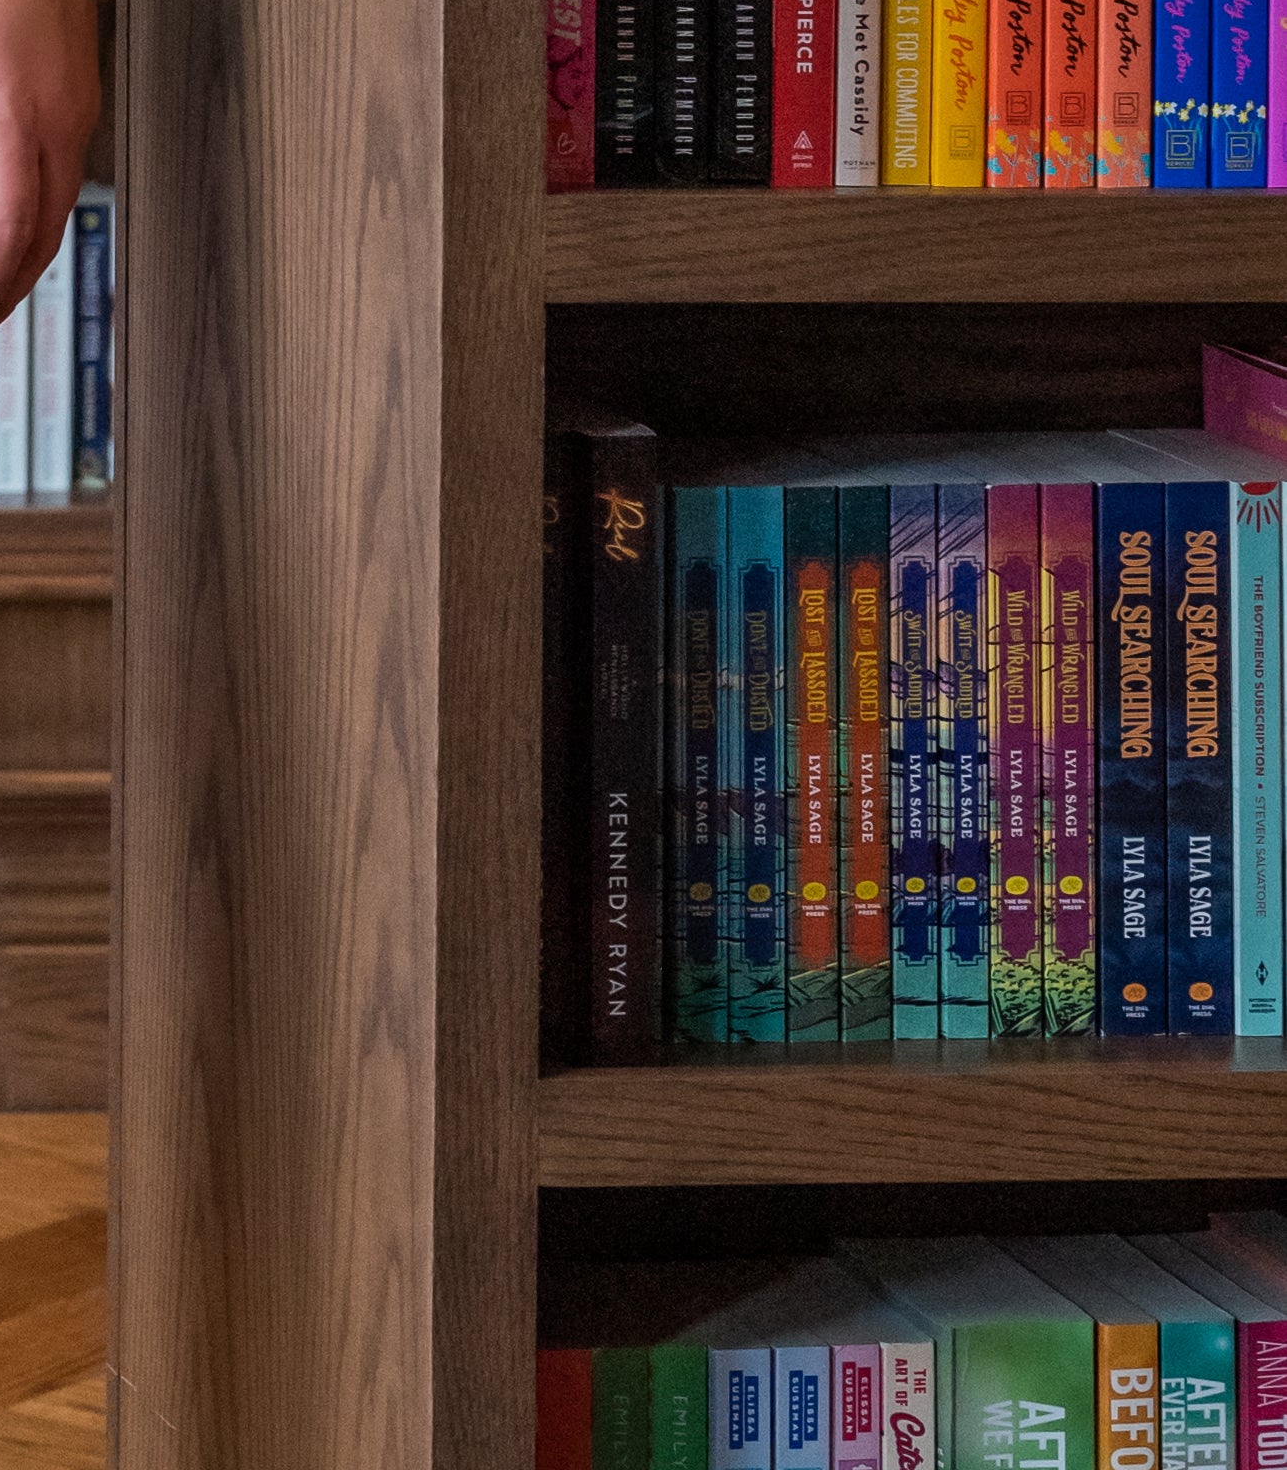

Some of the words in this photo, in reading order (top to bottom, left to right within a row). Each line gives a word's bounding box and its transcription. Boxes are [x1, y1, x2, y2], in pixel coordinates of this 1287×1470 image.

[854, 13, 870, 52] Met
[895, 33, 919, 61] FOR
[674, 76, 697, 155] PENRICK
[850, 59, 870, 137] Cassidy
[893, 68, 919, 170] COMMUTING
[1111, 530, 1152, 622] SOUL
[1253, 575, 1264, 601] THE
[1253, 603, 1265, 679] BOYFRIEND
[1119, 604, 1153, 759] SEARCHING
[1254, 682, 1266, 777] SUBSCRIPTION
[1255, 795, 1266, 846] STEVEN
[608, 792, 628, 929] KENNEDY
[1123, 836, 1146, 884] LYLA
[1255, 848, 1267, 918] SALVATORE
[1123, 887, 1146, 939] SAGE
[608, 944, 627, 1017] RYAN
[845, 1368, 854, 1434] SUSSMAN
[860, 1376, 869, 1426] ELISSA
[894, 1358, 908, 1385] ART
[894, 1389, 909, 1407] OF
[913, 1368, 927, 1394] THE
[983, 1400, 1014, 1447] WE
[1161, 1377, 1186, 1439] EVER
